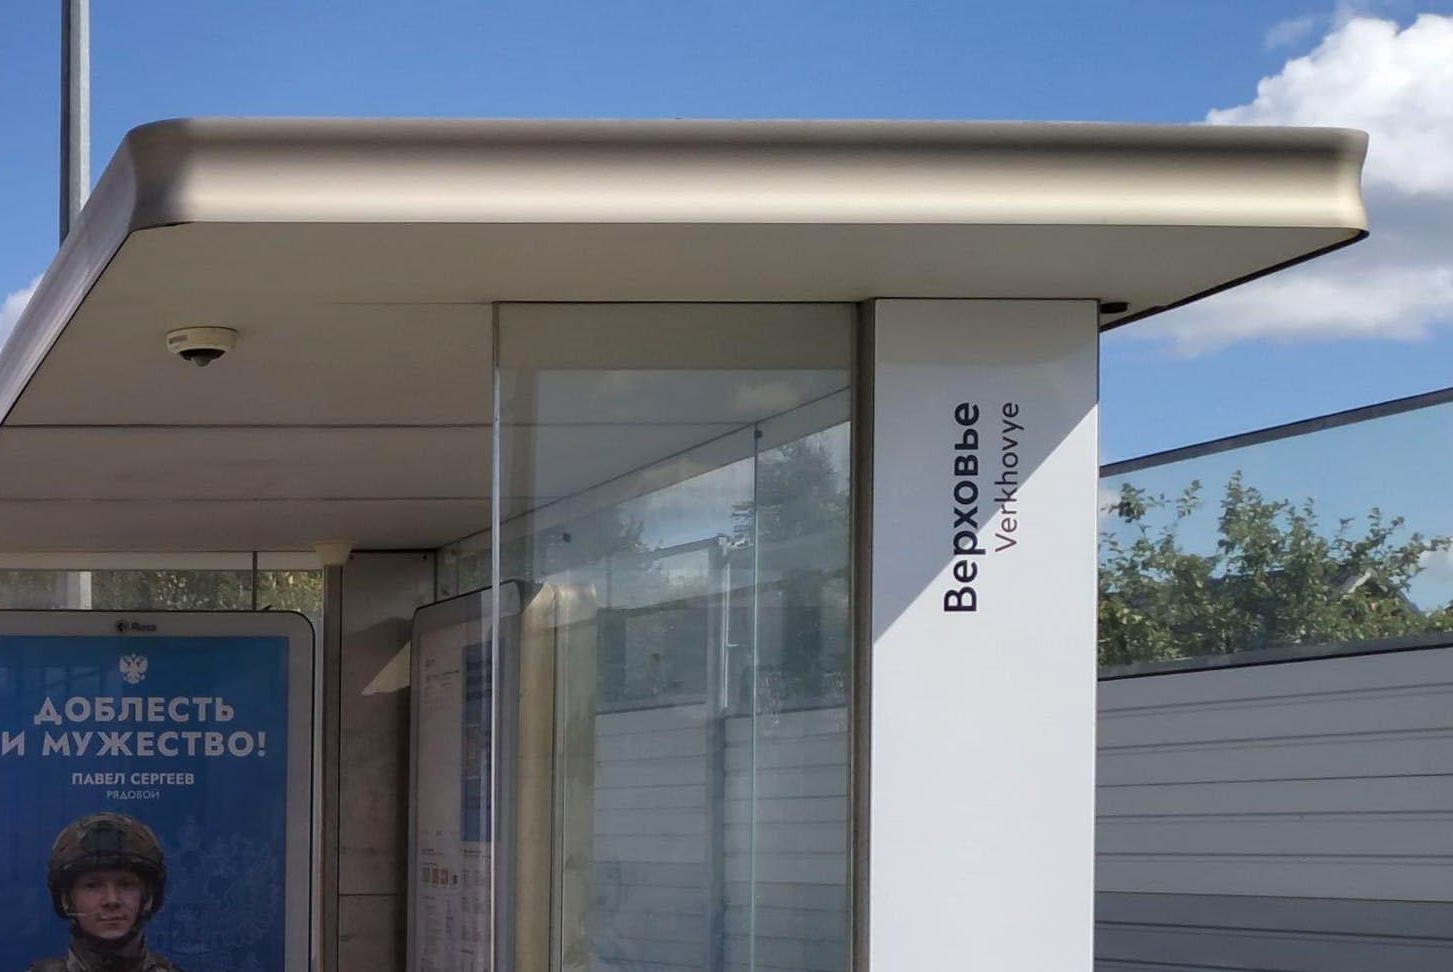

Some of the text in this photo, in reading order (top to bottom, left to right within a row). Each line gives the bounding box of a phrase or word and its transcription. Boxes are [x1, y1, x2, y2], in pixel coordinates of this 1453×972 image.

[995, 402, 1024, 552] Verkhovye
[944, 402, 985, 611] Верховье
[34, 697, 235, 725] ДОБЛЕСТЬ
[1, 731, 267, 757] И МУЖЕСТВО!
[71, 772, 195, 785] ПАВЕЛ СЕРГЕЕВ
[106, 789, 160, 800] РЯДОВОЙ
